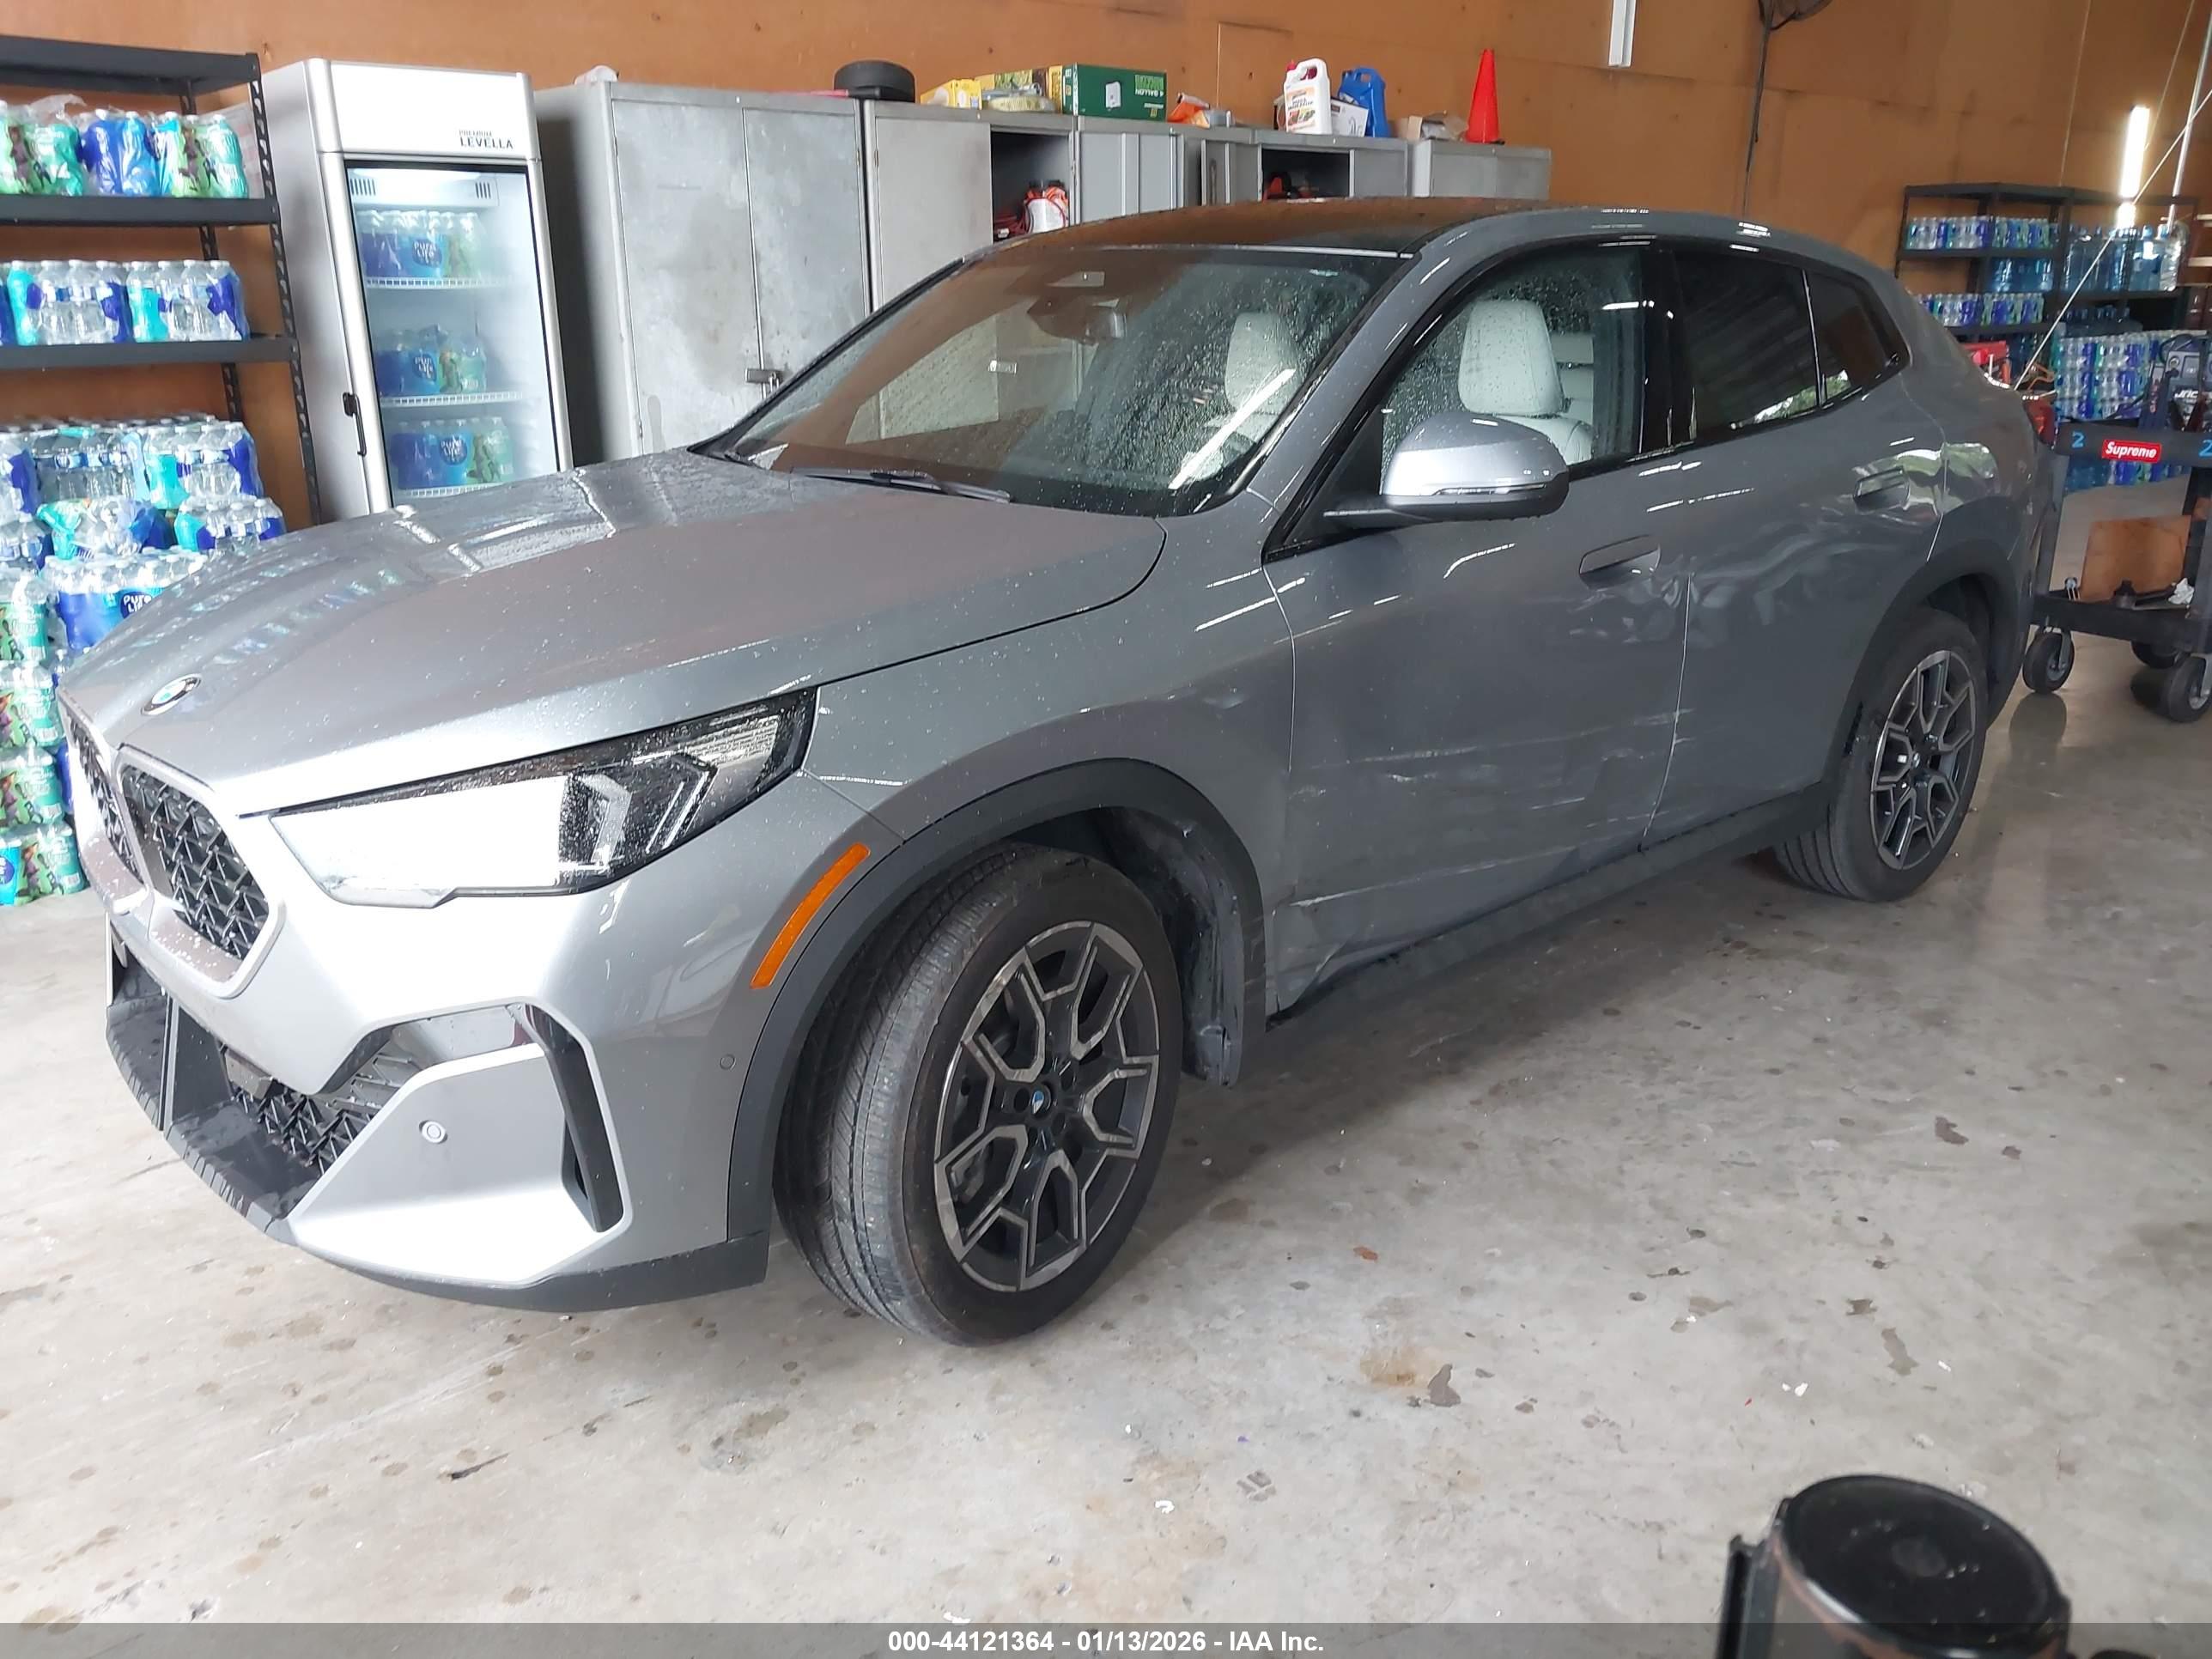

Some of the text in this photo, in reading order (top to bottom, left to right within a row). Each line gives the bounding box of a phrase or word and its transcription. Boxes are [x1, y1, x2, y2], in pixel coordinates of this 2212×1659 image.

[459, 137, 514, 149] LEVELLA
[2071, 431, 2085, 448] 2
[2105, 441, 2157, 459] Supreme
